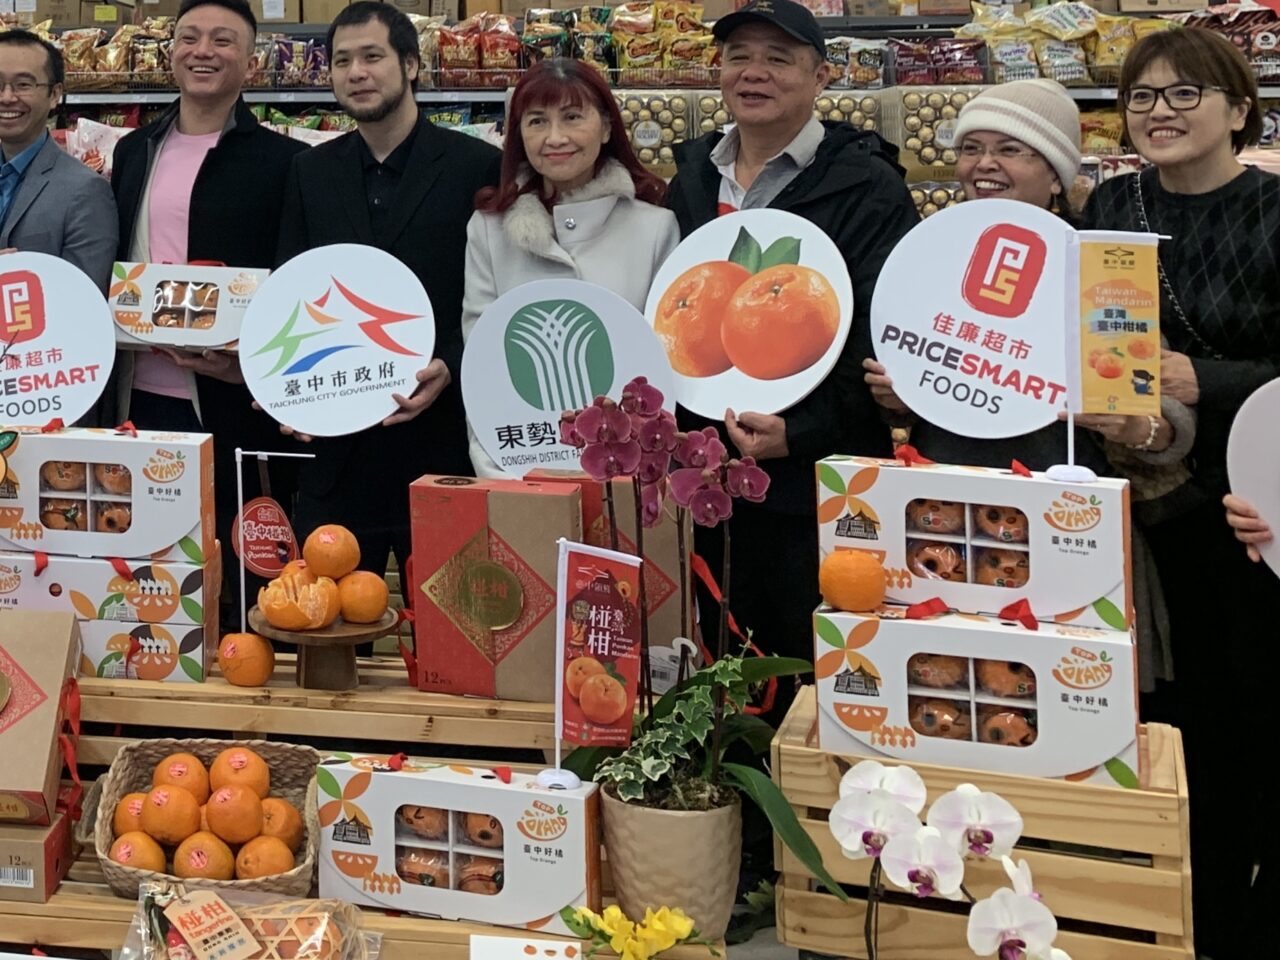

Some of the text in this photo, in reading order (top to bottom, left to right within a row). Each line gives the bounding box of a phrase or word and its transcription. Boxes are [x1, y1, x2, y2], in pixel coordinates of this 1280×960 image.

[1095, 287, 1137, 296] Taiwan
[1095, 297, 1152, 307] Mandarin
[1104, 309, 1126, 319] 臺灣
[1097, 320, 1148, 333] 臺中柑橘
[932, 311, 1033, 361] 佳廉超市
[880, 325, 1066, 408] PRICESMART
[284, 362, 397, 397] 臺中市政府
[268, 378, 406, 410] TAICHUNG CITY GOVERNMENT
[919, 370, 1004, 415] FOODS
[501, 453, 538, 467] DONGSHIH
[539, 451, 570, 464] DISTRICT
[1052, 536, 1097, 549] 臺中好橘
[588, 605, 611, 656] 椪柑
[423, 670, 439, 684] 12
[1061, 693, 1108, 707] 臺中好橘
[524, 844, 563, 857] 臺中好橘
[8, 855, 21, 865] 12
